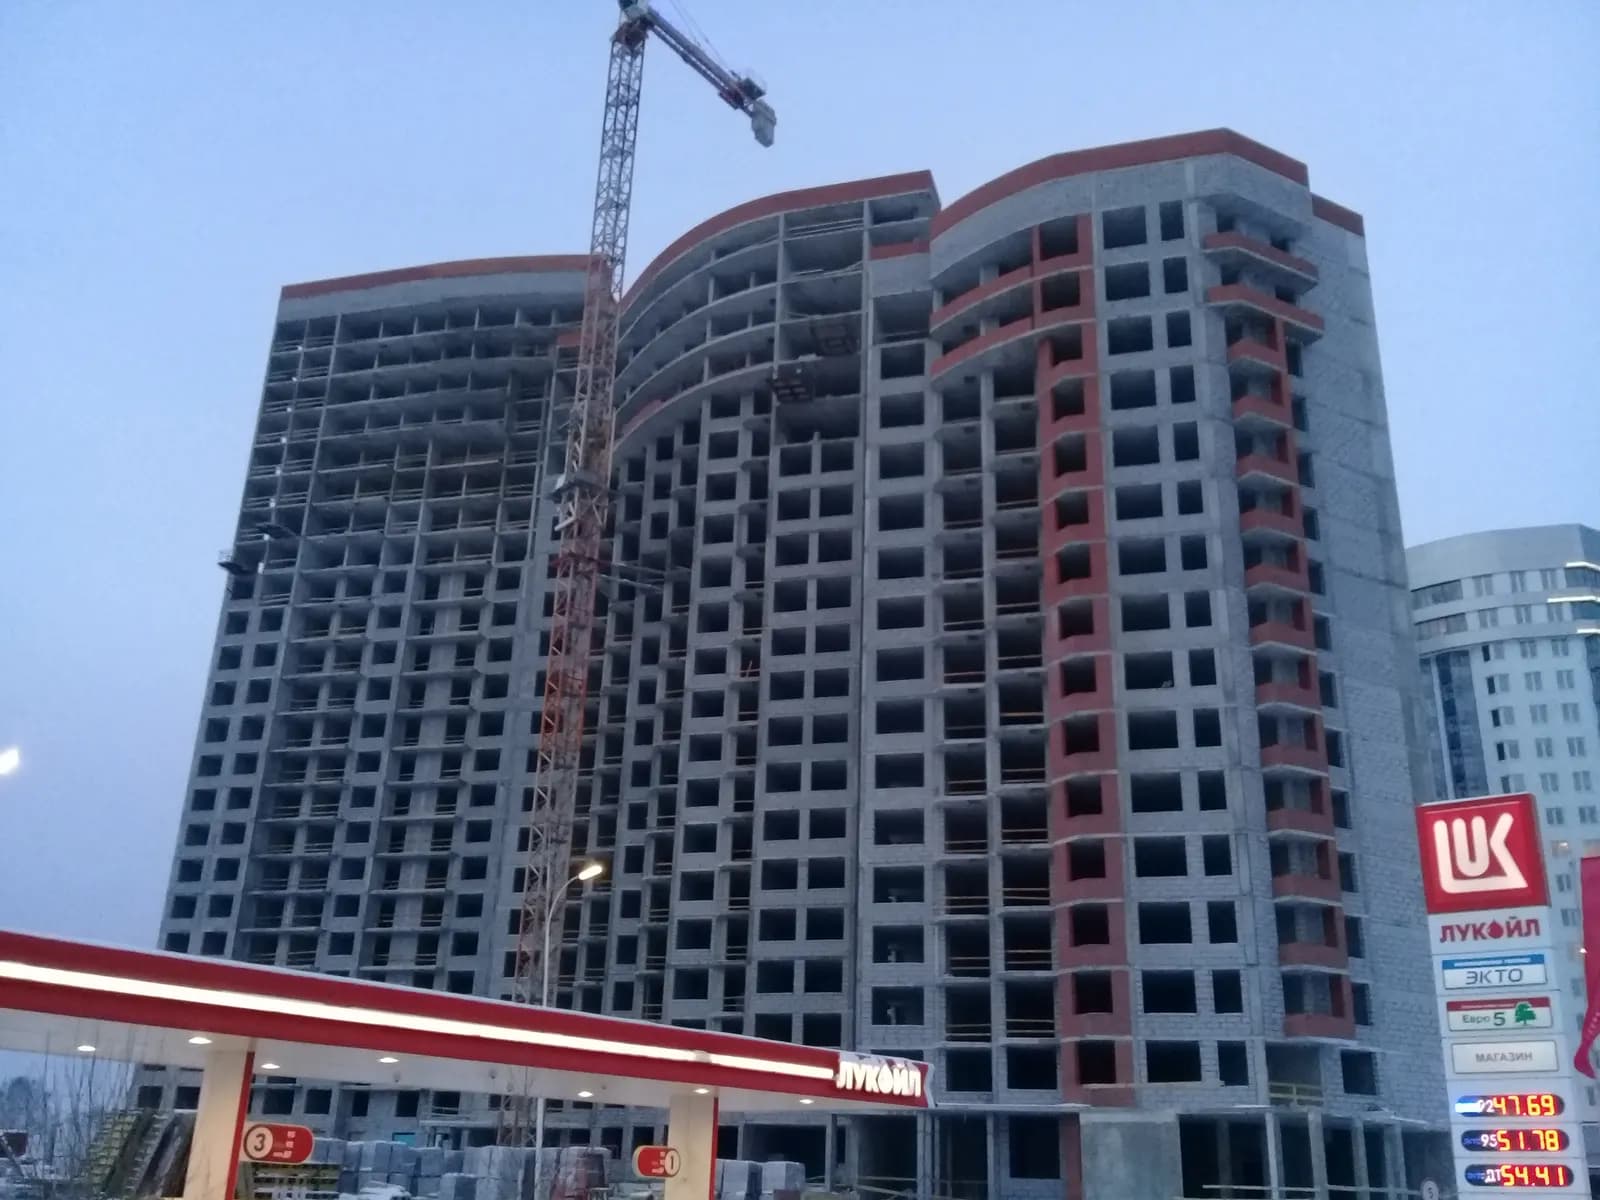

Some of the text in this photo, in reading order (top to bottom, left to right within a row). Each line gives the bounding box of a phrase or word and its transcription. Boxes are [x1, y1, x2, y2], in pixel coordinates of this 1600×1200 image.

[1440, 916, 1540, 943] ЛУКОЙЛ
[1465, 968, 1523, 985] ЭКТО
[1462, 1011, 1506, 1027] Евро 5
[1475, 1051, 1533, 1064] МАГАЗИН
[836, 1060, 922, 1098] ЛУКОЙЛ
[1493, 1094, 1555, 1116] 47.69
[254, 1132, 266, 1152] 3
[1480, 1134, 1498, 1147] 95
[1496, 1129, 1560, 1151] 51.78
[1484, 1169, 1502, 1184] ДТ
[1501, 1164, 1564, 1187] 54.41
